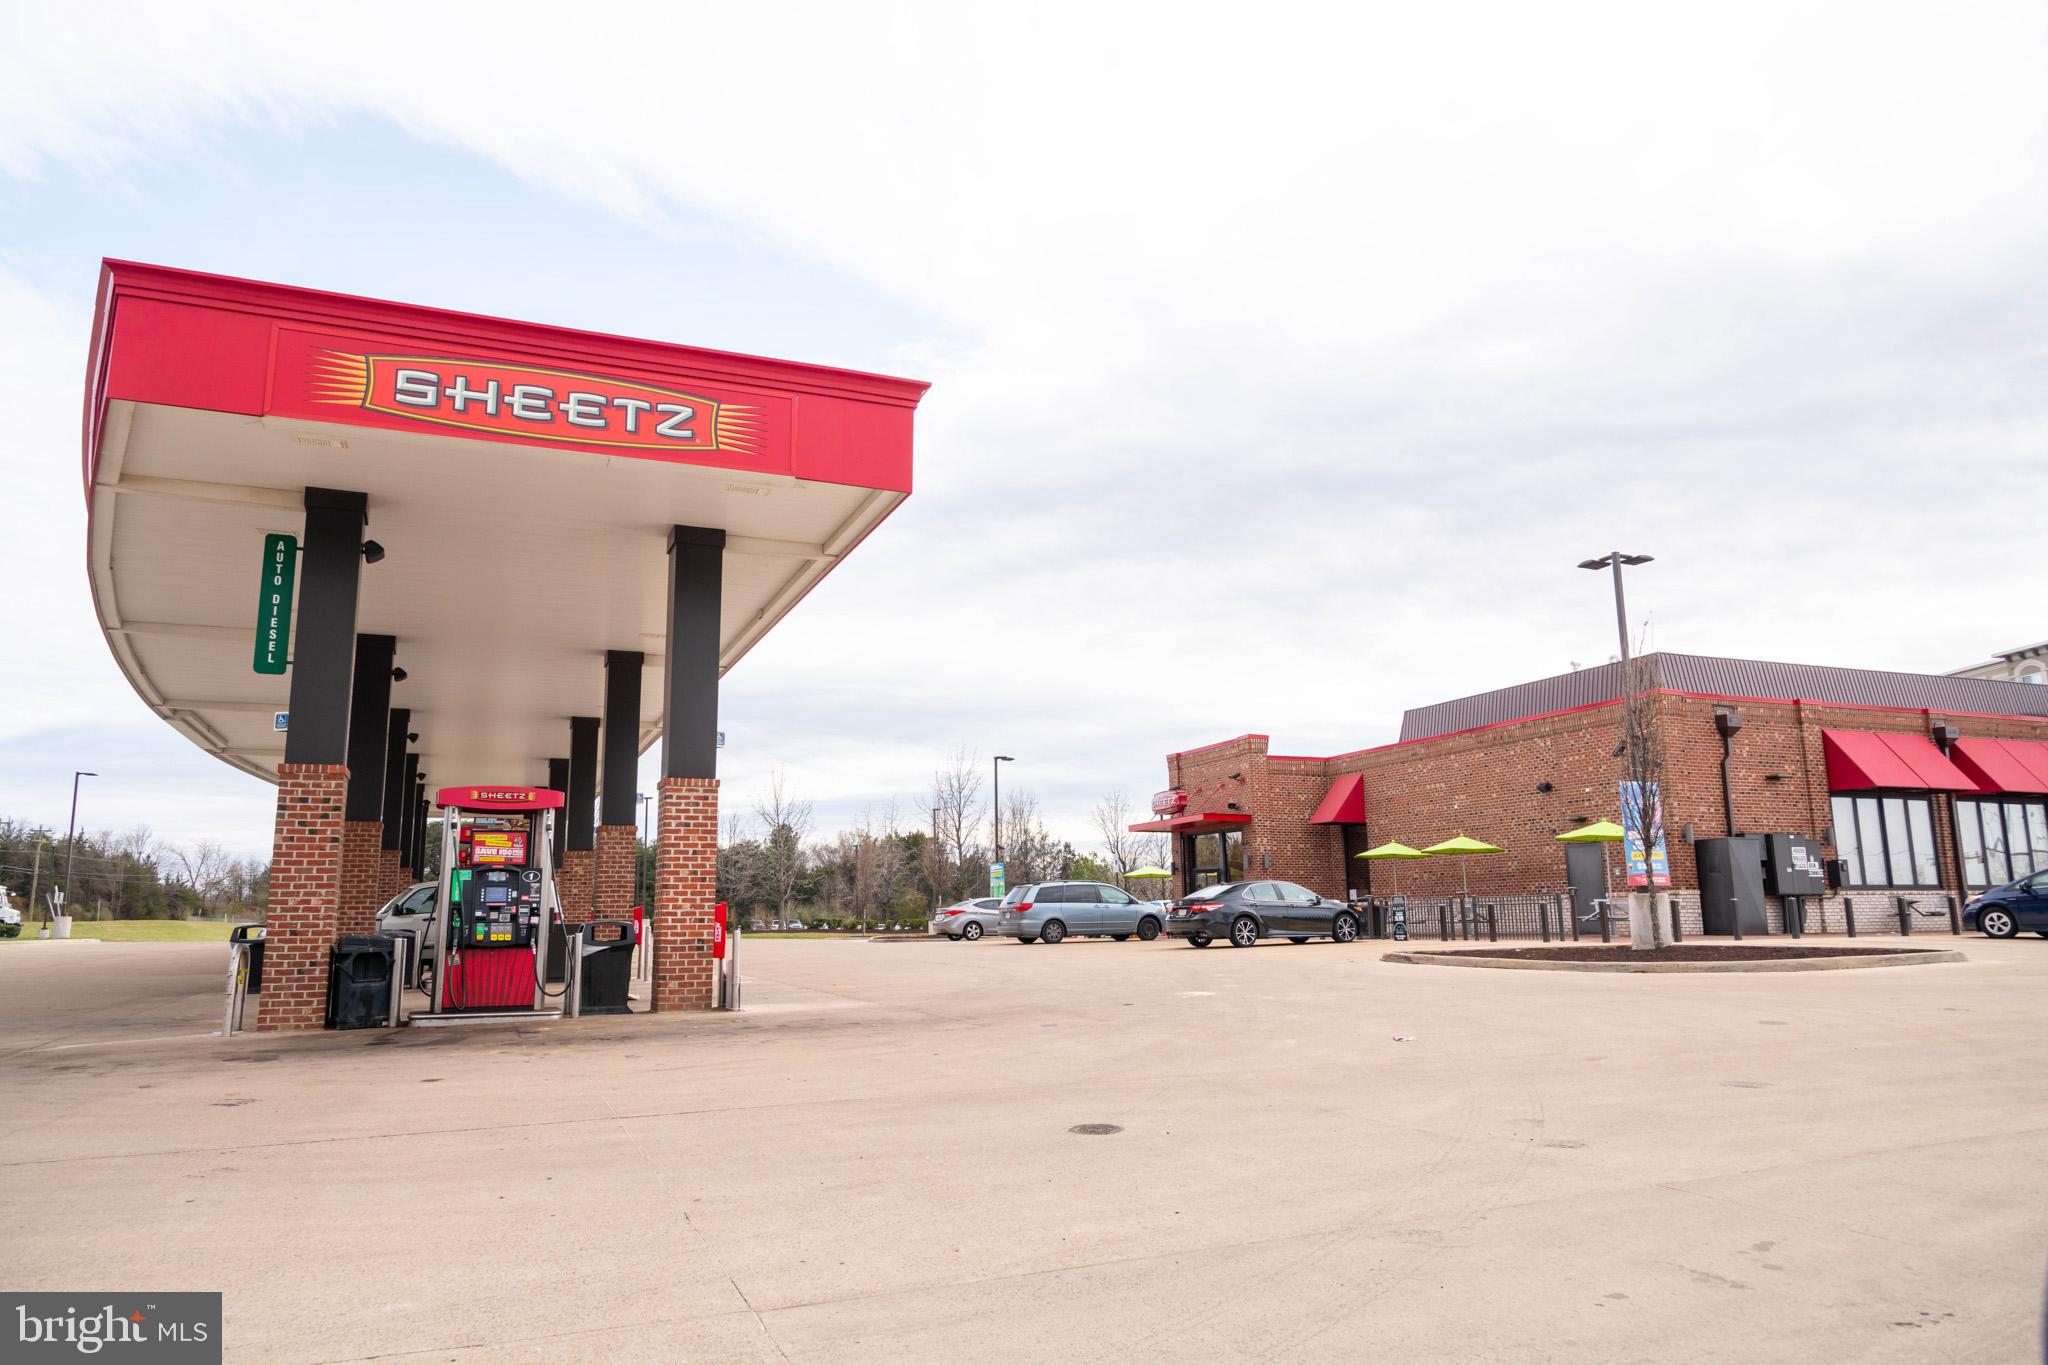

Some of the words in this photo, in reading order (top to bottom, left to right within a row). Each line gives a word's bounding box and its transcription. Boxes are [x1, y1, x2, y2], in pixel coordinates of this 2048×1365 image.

[394, 368, 695, 439] SHEETZ
[273, 540, 285, 586] AUTO
[267, 594, 281, 663] DIESEL
[480, 792, 526, 800] SHEETZ
